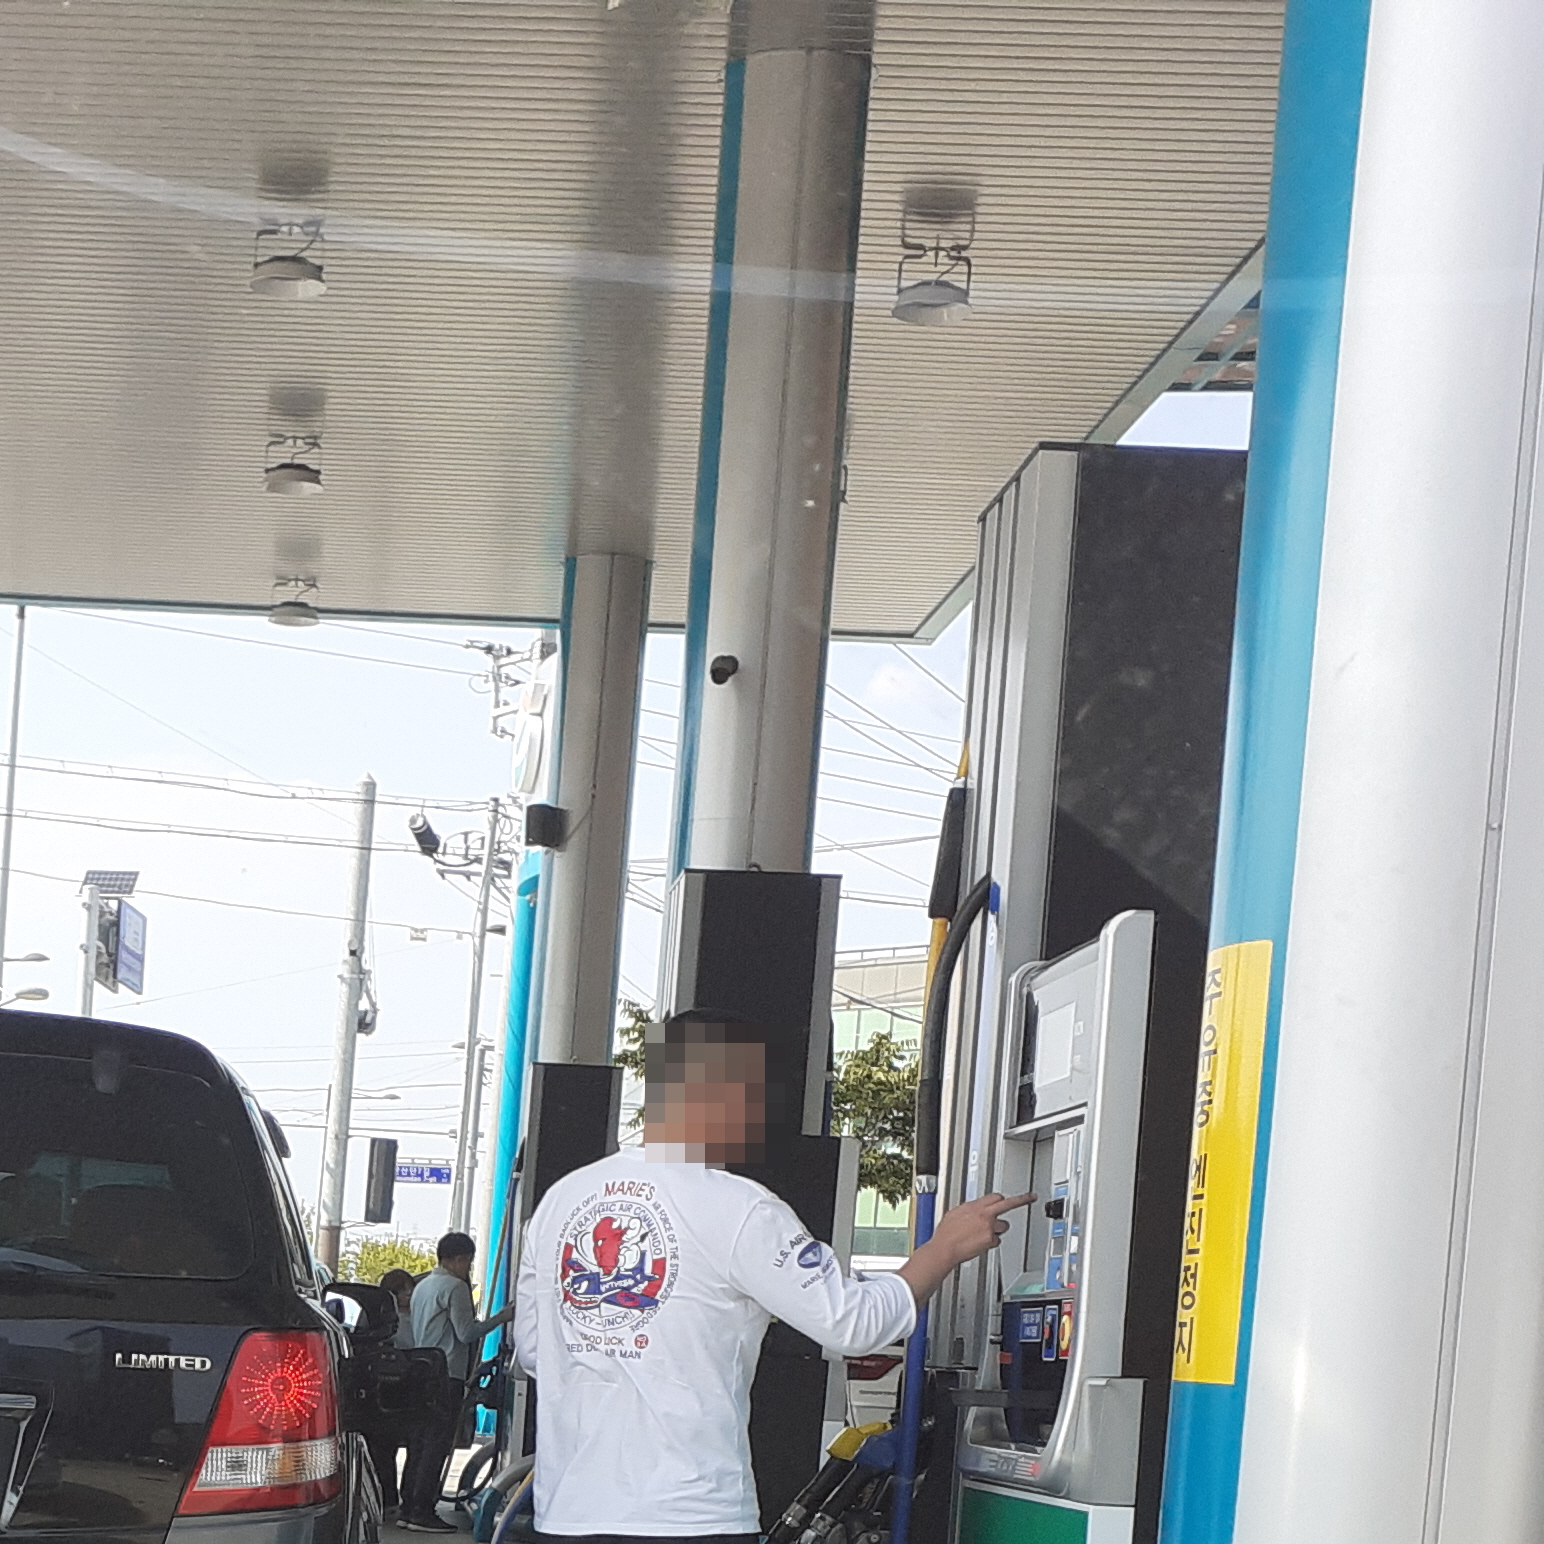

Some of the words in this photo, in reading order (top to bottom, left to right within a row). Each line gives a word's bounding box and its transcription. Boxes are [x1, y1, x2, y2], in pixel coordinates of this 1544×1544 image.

[1195, 967, 1222, 1129] 주유중
[604, 1181, 655, 1201] MARIE'S
[1175, 1152, 1208, 1364] 엔진정지
[115, 1353, 212, 1372] LIMITED
